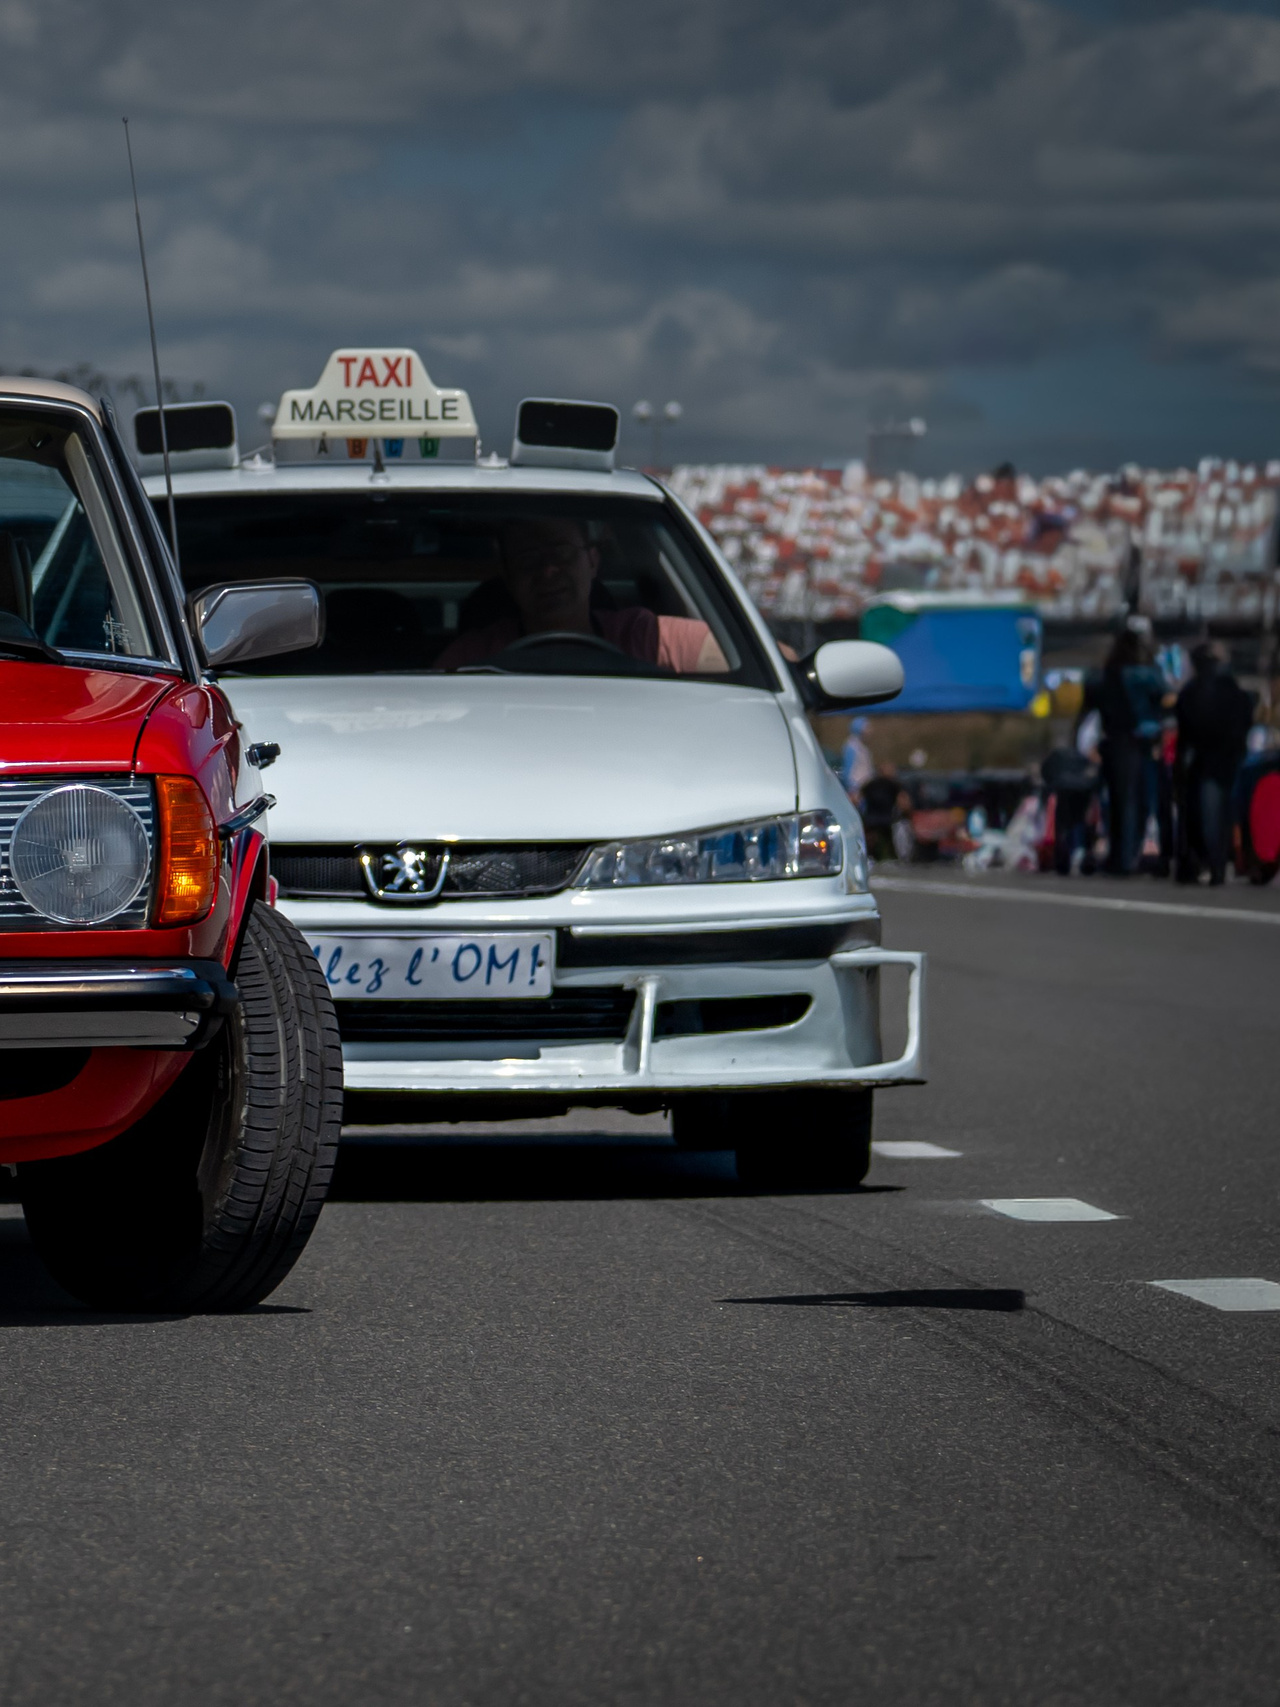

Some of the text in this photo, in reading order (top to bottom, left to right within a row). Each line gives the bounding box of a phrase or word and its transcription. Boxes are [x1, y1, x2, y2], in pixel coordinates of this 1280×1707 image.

[337, 357, 412, 388] TAXI
[290, 399, 460, 422] MARSEILLE
[313, 943, 541, 993] lez l'OM!
